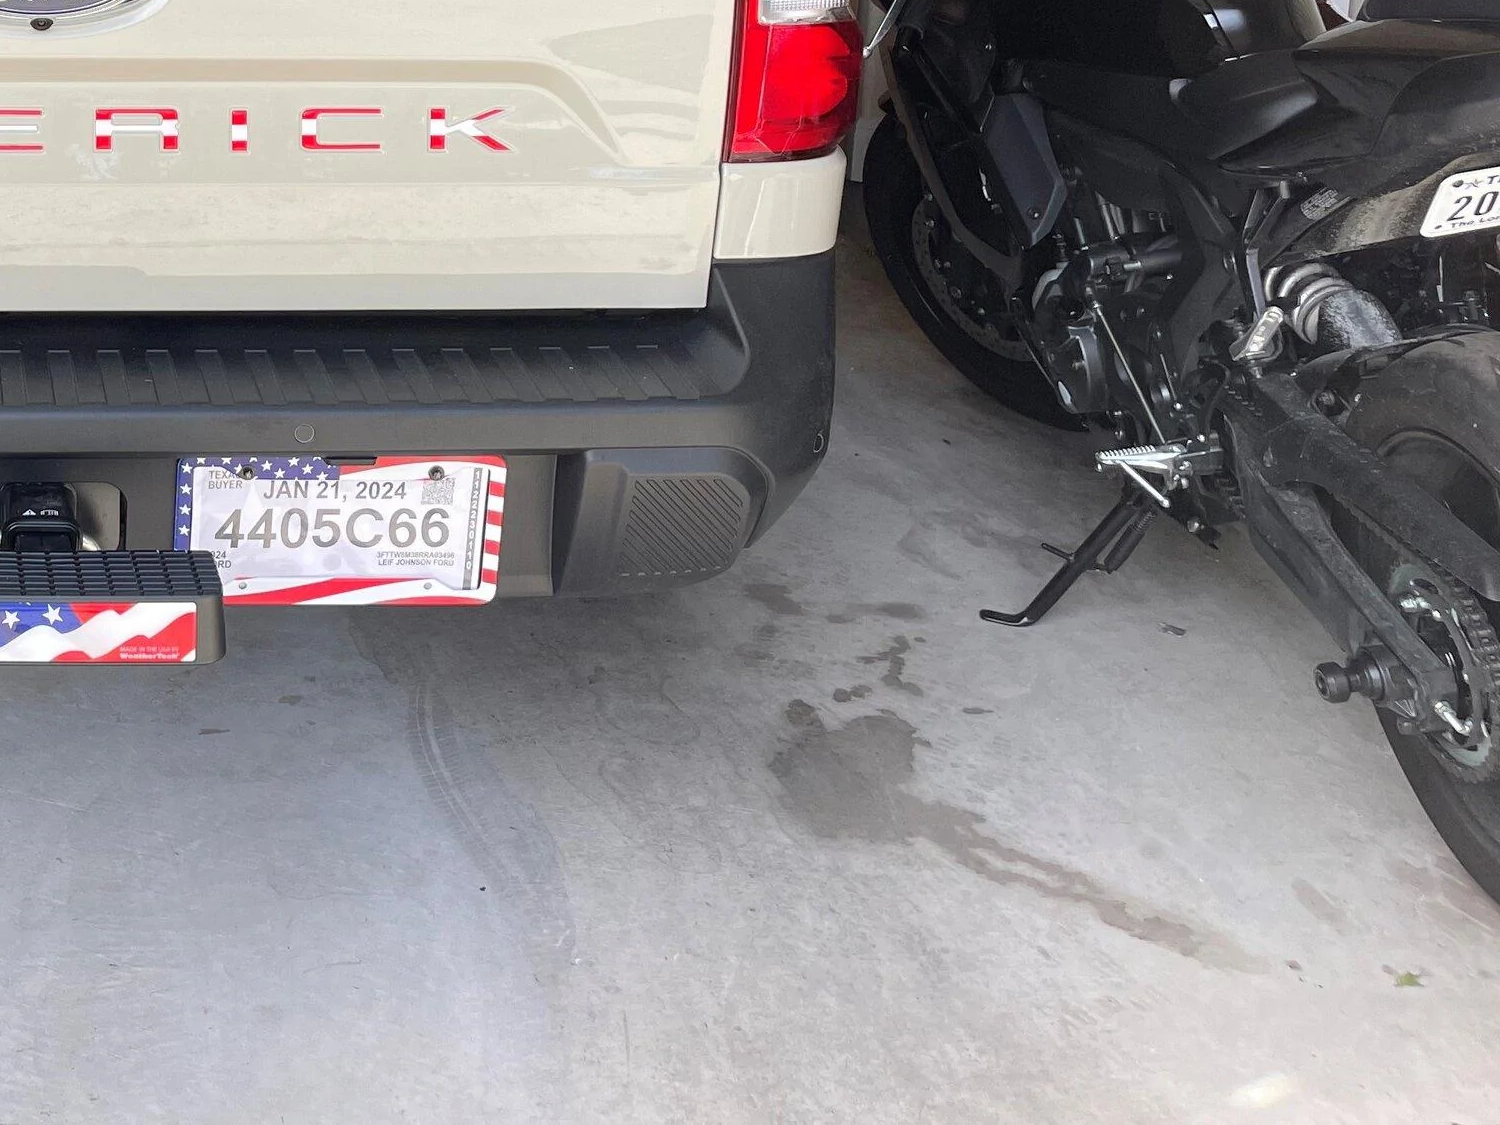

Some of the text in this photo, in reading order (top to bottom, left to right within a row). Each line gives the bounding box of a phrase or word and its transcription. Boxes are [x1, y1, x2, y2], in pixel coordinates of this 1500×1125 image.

[1487, 174, 1500, 185] T
[1451, 220, 1475, 229] The
[208, 470, 236, 480] TEXA
[208, 480, 243, 490] BUYER
[263, 480, 407, 503] JAN 21, 2024
[214, 507, 450, 549] 4405C66
[211, 550, 227, 560] 024
[377, 558, 455, 567] LEIF JOHNSON FORD
